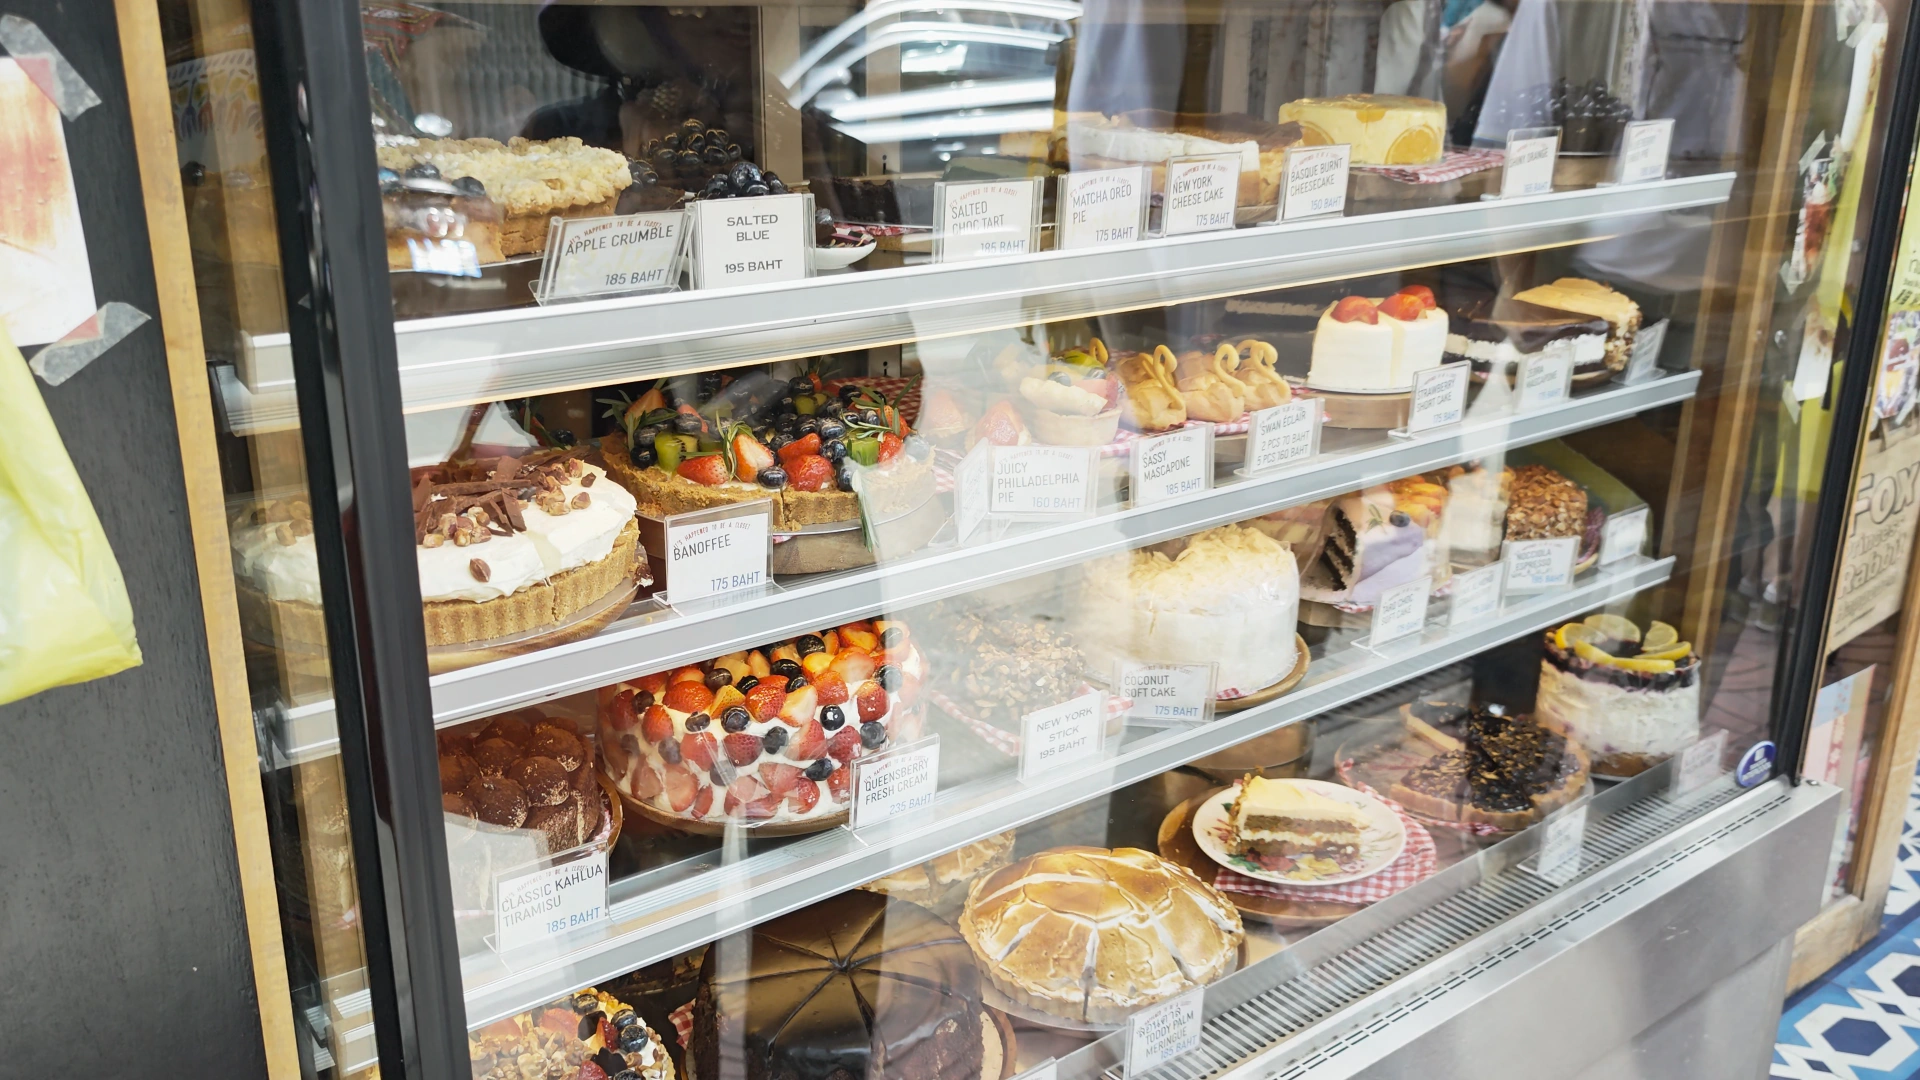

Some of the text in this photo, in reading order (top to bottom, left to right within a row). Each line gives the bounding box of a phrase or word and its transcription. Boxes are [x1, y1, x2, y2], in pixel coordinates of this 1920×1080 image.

[1291, 164, 1319, 183] BASQUE
[1320, 157, 1343, 175] BURNT
[1172, 174, 1213, 195] NEW YORK
[1290, 173, 1335, 197] CHEESECAKE
[1072, 184, 1132, 208] MATCHA OREO
[1172, 186, 1224, 210] CHEESE CAKE
[1311, 195, 1342, 211] 150 BAHT
[951, 200, 988, 220] SALTED
[1072, 210, 1087, 225] PIE
[1196, 211, 1231, 226] 175 BAHT
[726, 214, 779, 227] SALTED
[952, 214, 1005, 235] CHOC TART
[565, 225, 674, 256] APPLE CRUMBLE
[736, 229, 770, 242] BLUE
[1096, 226, 1134, 242] 175 BAHT
[999, 239, 1026, 253] BAHT
[724, 259, 783, 274] 195 BAHT
[605, 268, 664, 286] 185 BAHT
[1417, 379, 1456, 400] STRAWBERRY
[1416, 391, 1452, 412] SHORT CAKE
[1261, 420, 1281, 436] SWAN
[1261, 430, 1310, 451] 2 PCS 70 BAHT
[1143, 450, 1167, 468] SASSY
[1263, 452, 1276, 464] PCS
[1277, 449, 1289, 461] 160
[1291, 444, 1308, 458] BAHT
[997, 462, 1028, 475] JUICY
[1144, 456, 1191, 482] MASCAPONE
[998, 472, 1080, 489] PHILLADELPHIA
[1166, 477, 1201, 495] 185 BAHT
[998, 491, 1014, 503] PIE
[1032, 497, 1082, 508] 160 BAHT
[673, 533, 731, 561] BANOFFEE
[711, 571, 760, 592] 175 BAHT
[1124, 675, 1169, 686] COCONUT
[1125, 687, 1176, 698] SOFT CAKE
[1037, 707, 1093, 732] NEW YORK
[1155, 705, 1199, 717] 175 BAHT
[1049, 725, 1079, 742] STICK
[1039, 736, 1087, 759] 195 BAHT
[865, 757, 929, 792] QUEENSBERRY
[865, 772, 928, 805] FRESH CREAM
[889, 793, 932, 815] 235 BAHT
[501, 864, 603, 913] CLASSIC KAHLUA
[503, 895, 561, 928] TIRAMISU
[546, 907, 601, 934] 185 BAHT
[1146, 1022, 1171, 1045] TODDY
[1173, 1010, 1194, 1030] PALM
[1146, 1026, 1187, 1058] MERINGUE
[1176, 1035, 1197, 1053] BAHT
